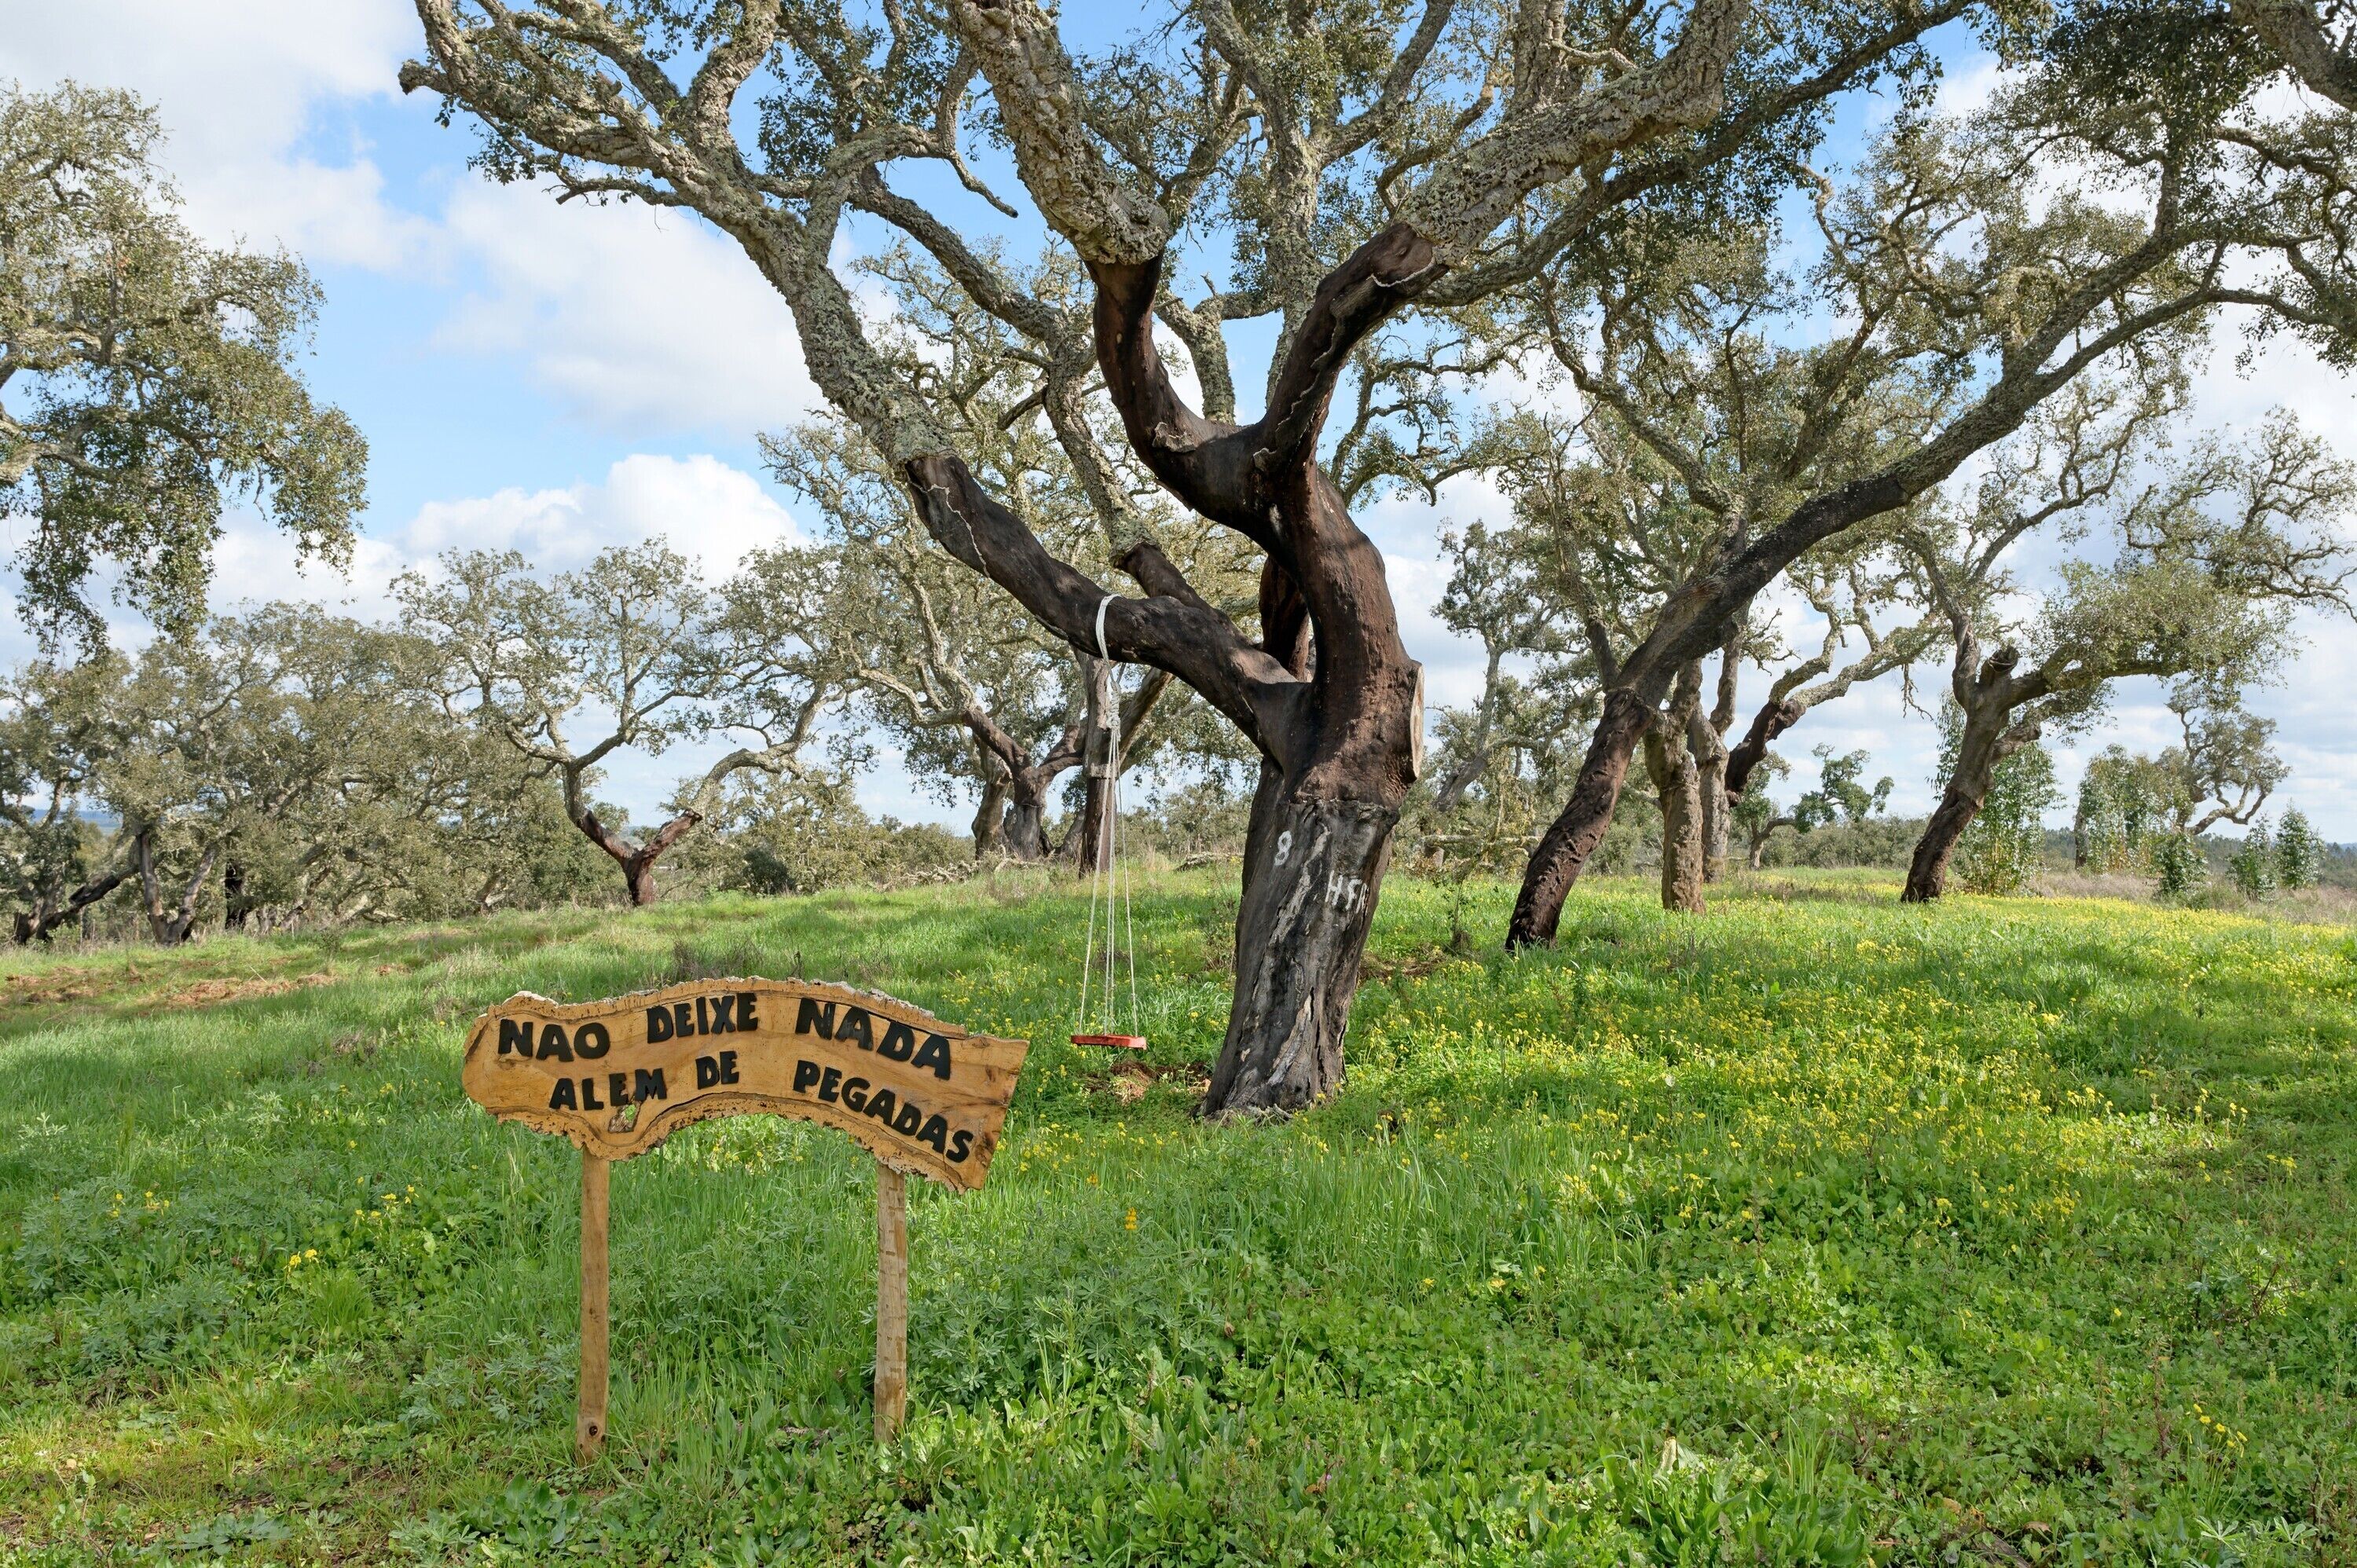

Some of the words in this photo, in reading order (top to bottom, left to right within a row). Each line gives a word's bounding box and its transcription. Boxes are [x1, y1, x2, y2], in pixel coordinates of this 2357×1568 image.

[498, 1018, 610, 1062] NAO
[647, 992, 759, 1044] DEIXE
[794, 997, 951, 1081] NADA
[549, 1068, 667, 1111] ALEM
[695, 1050, 740, 1090] DE
[793, 1060, 975, 1163] PEGADAS
